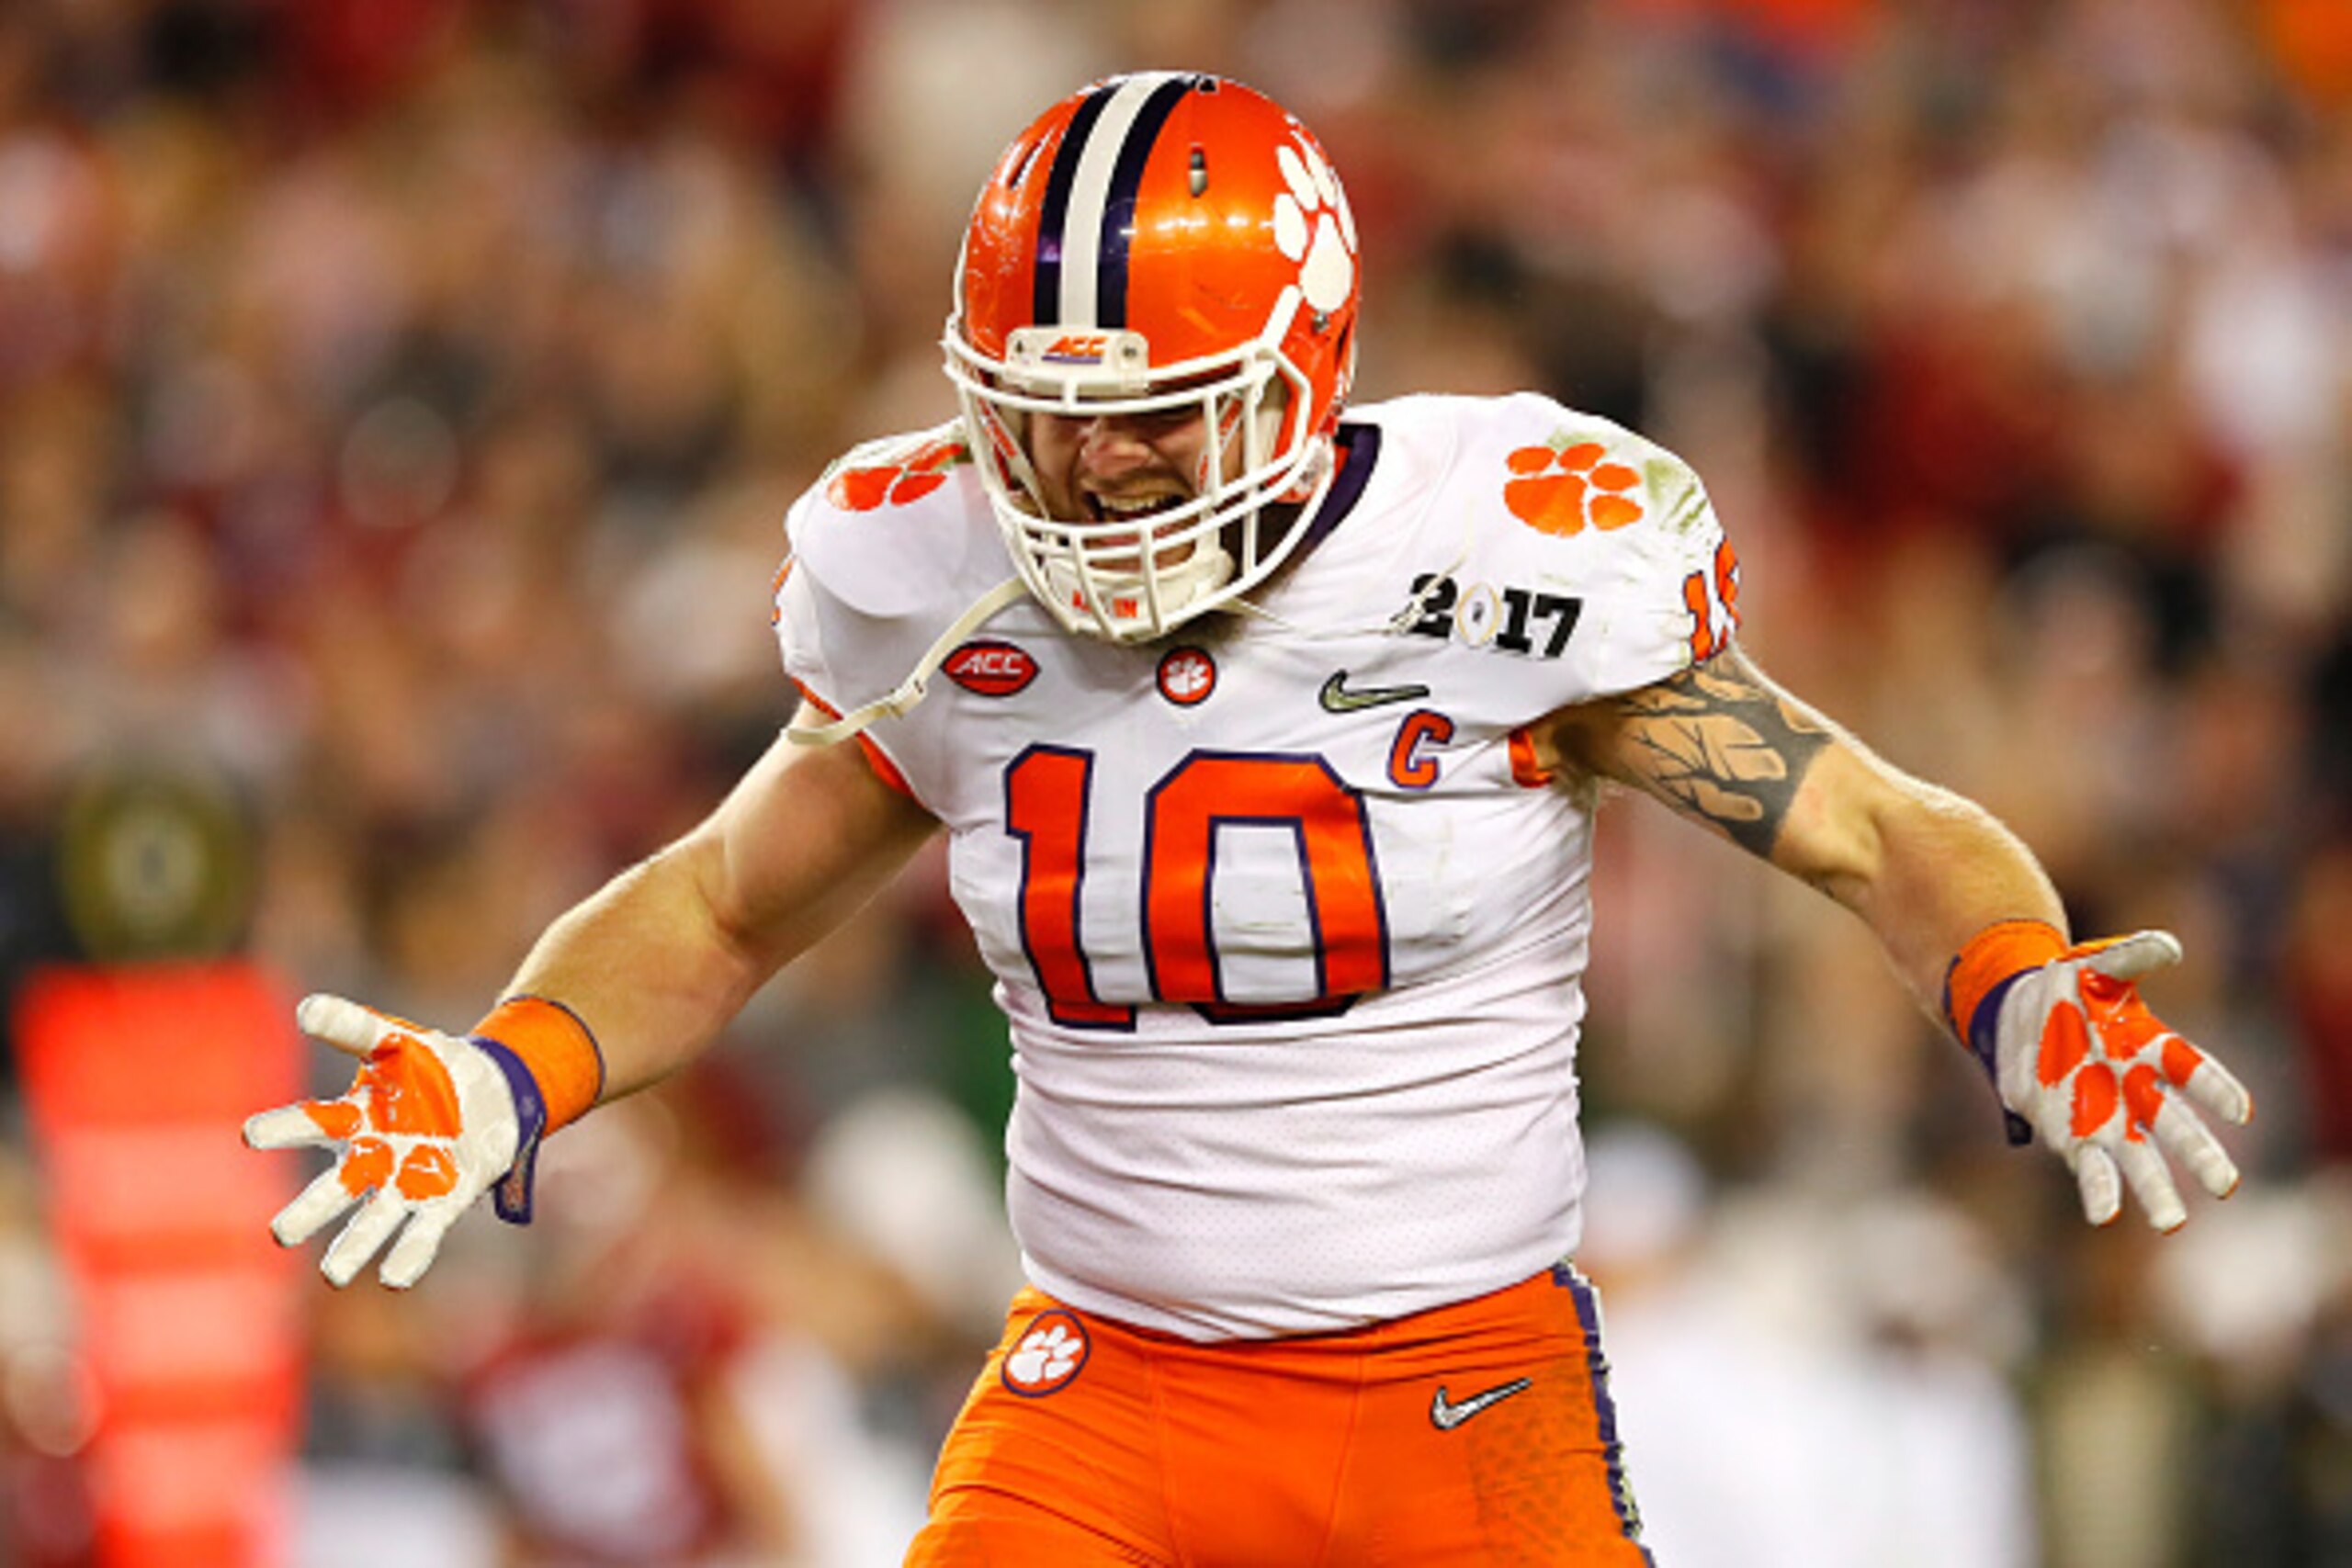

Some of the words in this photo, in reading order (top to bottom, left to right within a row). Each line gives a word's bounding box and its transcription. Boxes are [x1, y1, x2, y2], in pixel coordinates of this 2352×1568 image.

[1045, 336, 1108, 357] ACC
[953, 651, 1023, 675] ACC
[1386, 708, 1455, 790] C
[1002, 742, 1392, 1033] 10
